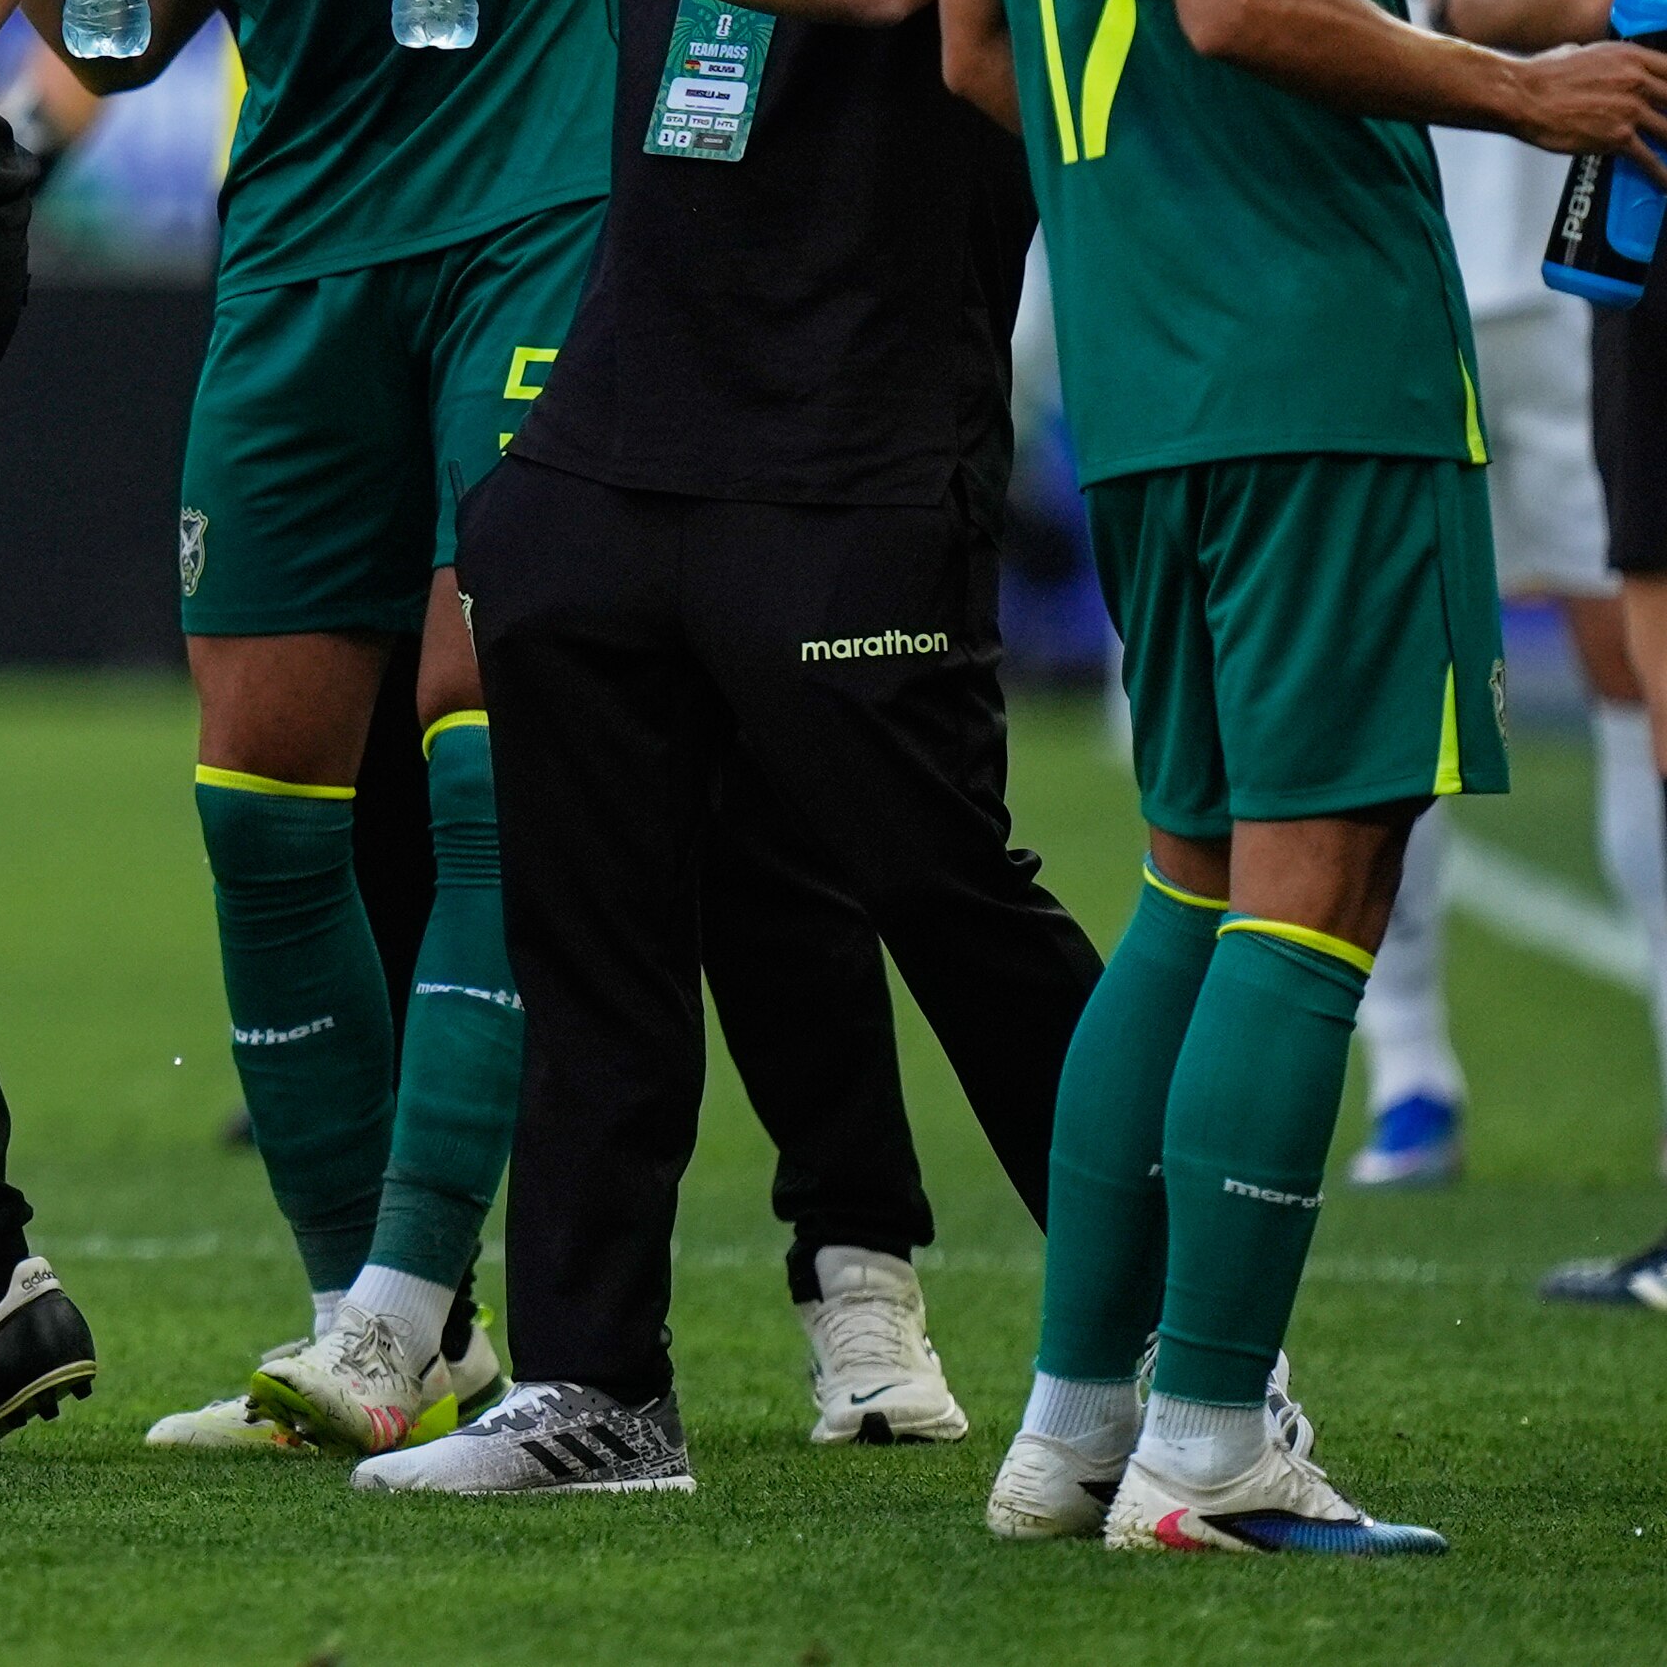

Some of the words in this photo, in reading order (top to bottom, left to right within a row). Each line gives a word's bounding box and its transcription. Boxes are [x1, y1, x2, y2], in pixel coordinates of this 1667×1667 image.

[689, 42, 720, 58] TEAM
[719, 45, 749, 60] PASS
[708, 65, 736, 74] BOLIVIA
[717, 120, 734, 128] HTL
[663, 134, 669, 142] 1
[679, 135, 687, 143] 2
[801, 629, 949, 662] marathon
